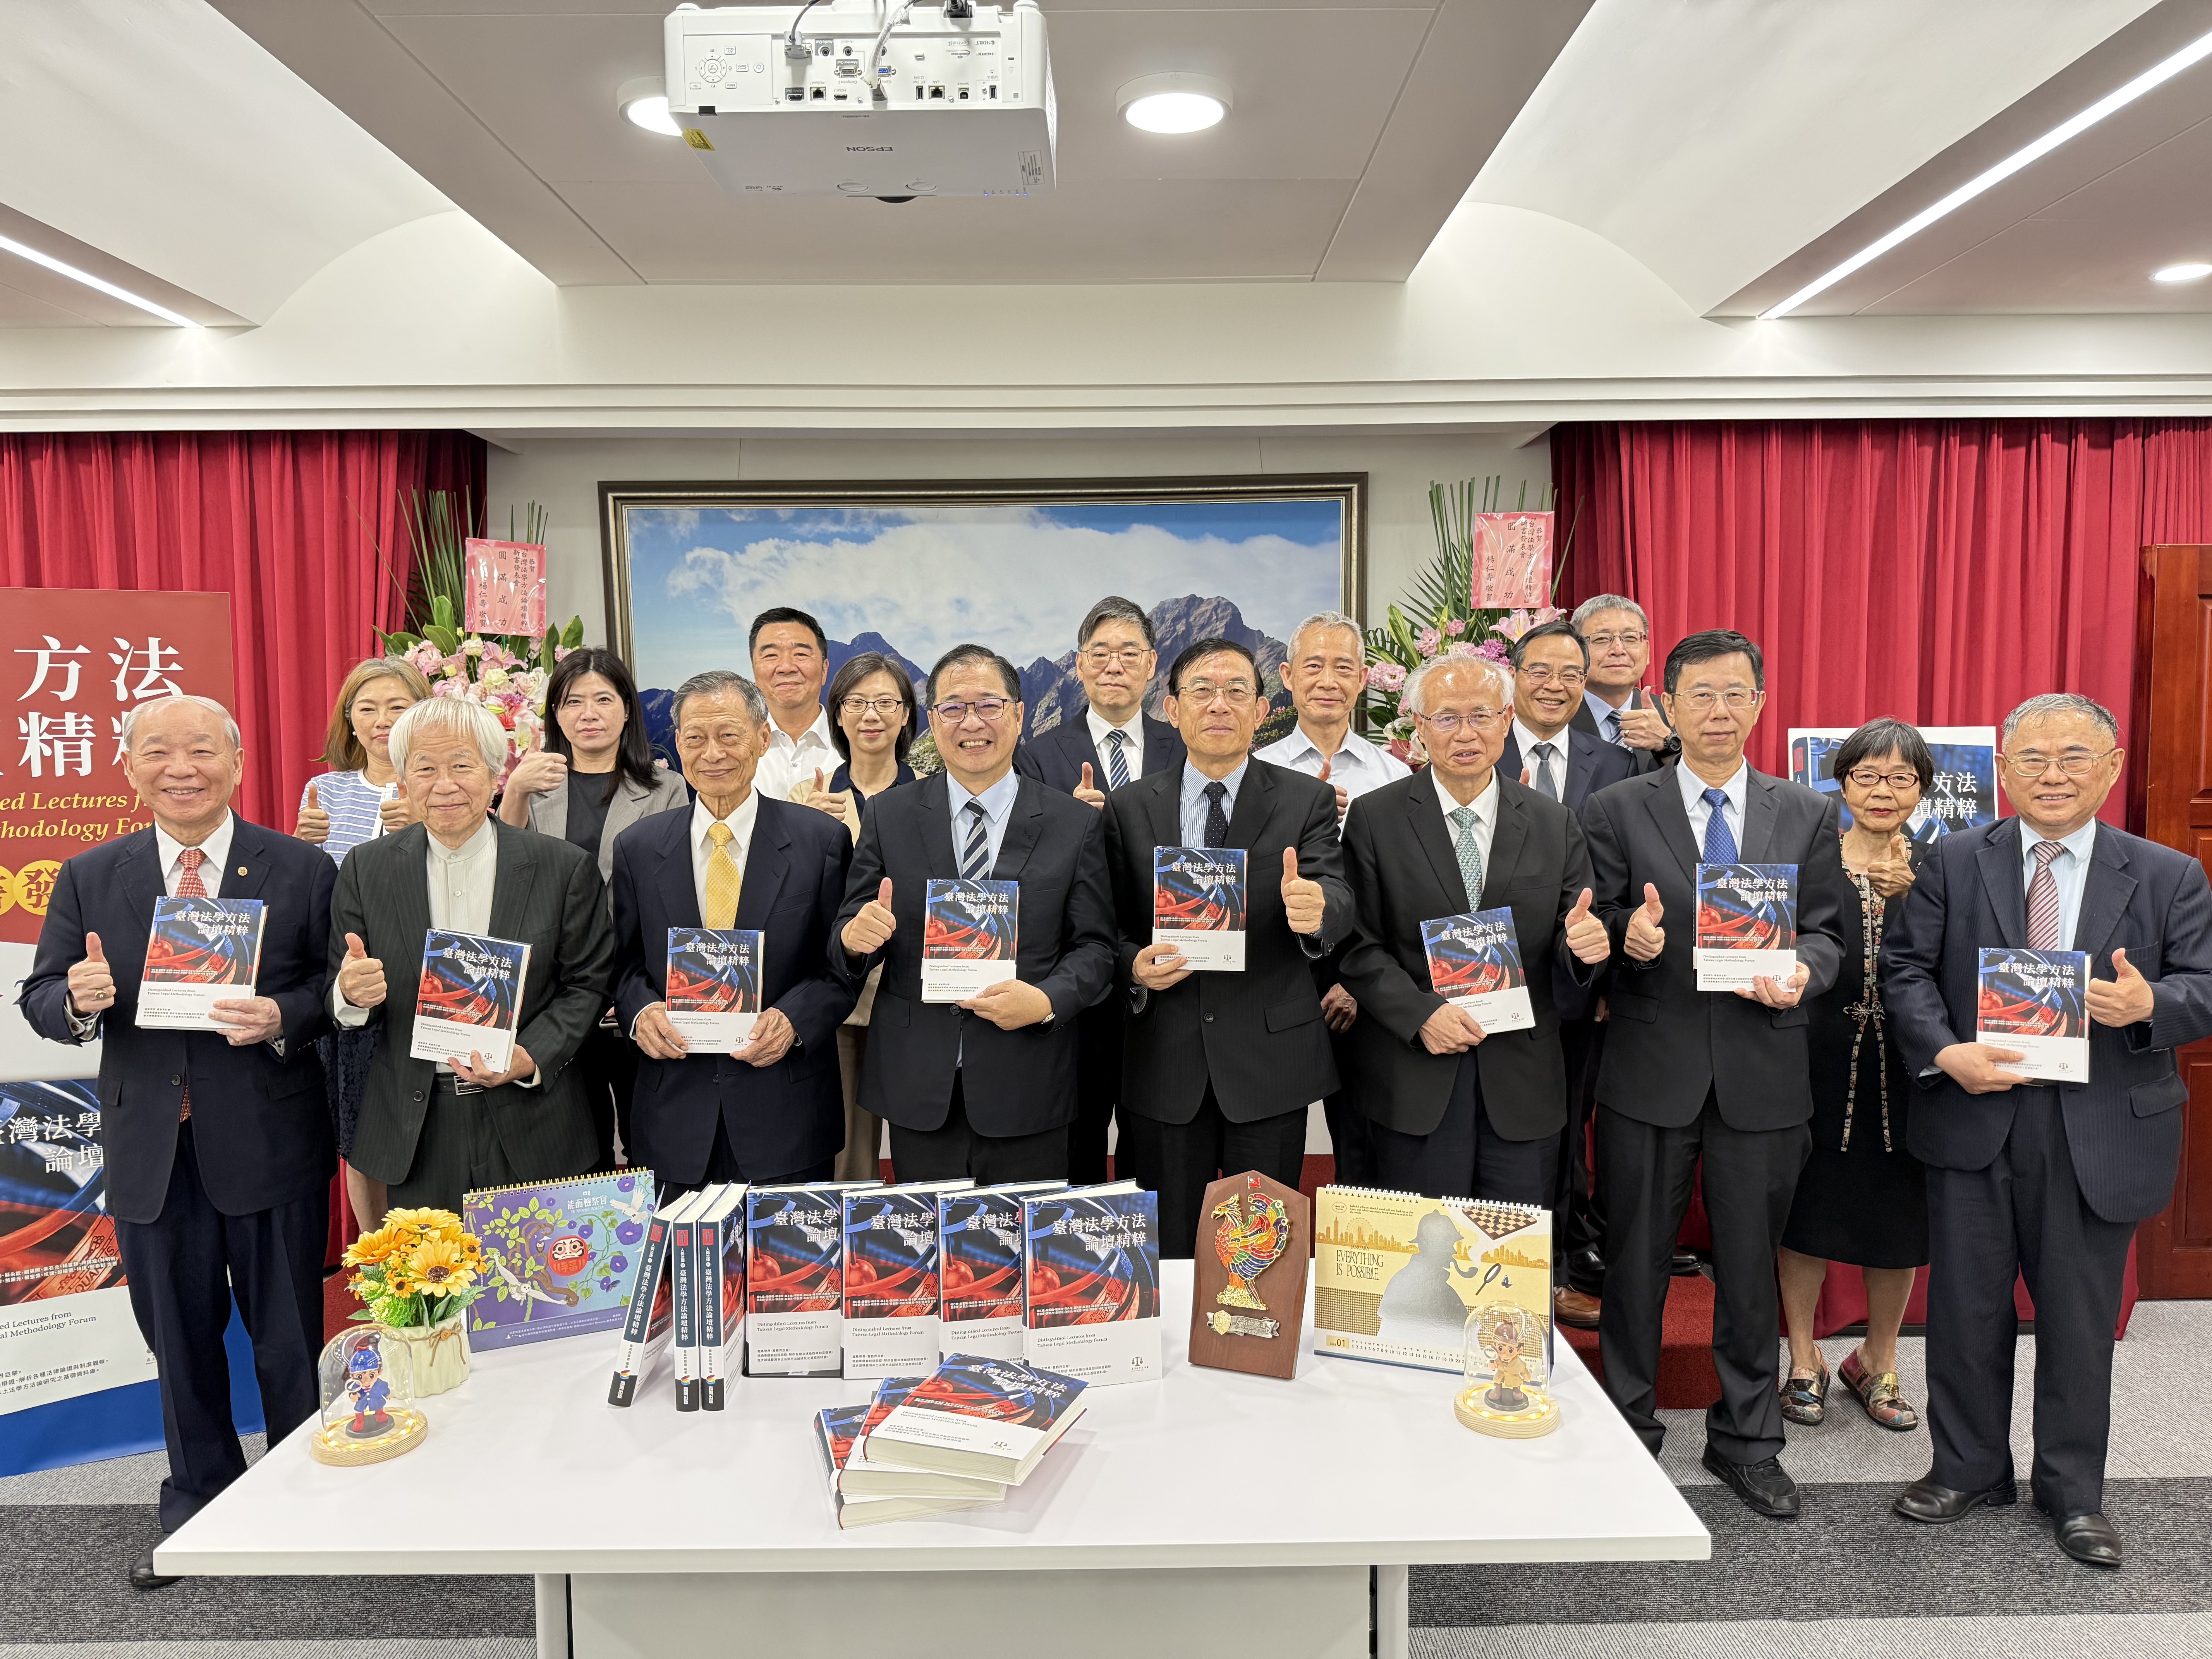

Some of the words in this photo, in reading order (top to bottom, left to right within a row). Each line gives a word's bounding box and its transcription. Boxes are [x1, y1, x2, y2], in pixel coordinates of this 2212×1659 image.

[14, 635, 184, 702] 方法
[1934, 771, 1977, 793] 方法
[31, 793, 127, 809] Lectures
[0, 819, 109, 842] hodology
[1171, 862, 1236, 873] 臺灣法學方法
[1193, 875, 1236, 885] 論壇精粹
[1716, 878, 1788, 889] 臺灣法學方法
[944, 892, 1009, 903] 臺灣法學方法
[1741, 891, 1788, 902] 論壇精粹
[175, 910, 251, 924] 臺灣法學方法
[965, 904, 1008, 915] 論壇精粹
[198, 924, 248, 936] 論壇精粹
[1441, 921, 1506, 941] 臺灣法學方法
[685, 942, 750, 954] 臺灣法學方法
[1465, 933, 1508, 949] 論壇精粹
[443, 948, 512, 968] 臺灣法學方法
[707, 955, 749, 966] 論壇精粹
[464, 964, 510, 980] 論壇精粹
[1998, 962, 2074, 976] 臺灣法學方法
[2023, 976, 2074, 988] 論壇精粹
[0, 1113, 101, 1144] 灣法學
[44, 1143, 104, 1173] 論壇
[773, 1209, 838, 1226] 臺灣法學
[871, 1212, 934, 1230] 臺灣法學
[1052, 1212, 1146, 1235] 臺灣法學方法
[807, 1227, 838, 1242] 論壇
[903, 1230, 934, 1246] 論壇
[1085, 1231, 1146, 1251] 論壇精粹
[1336, 1249, 1384, 1267] EVERYTHING
[562, 1262, 580, 1273] 福
[1336, 1263, 1342, 1276] IS
[1347, 1265, 1379, 1280] POSSIBLE
[631, 1264, 652, 1336] 臺灣法學方法論壇精粹
[680, 1269, 689, 1341] 臺灣法學方法論壇精粹
[705, 1269, 714, 1341] 臺灣法學方法論壇精粹
[10, 1322, 66, 1337] Methodology
[69, 1317, 96, 1325] Forum
[12, 1316, 49, 1328] Lectures
[52, 1312, 71, 1320] from
[1337, 1339, 1345, 1347] 01
[966, 1364, 1067, 1393] 臺灣法學方法
[992, 1379, 1062, 1399] 論壇精粹
